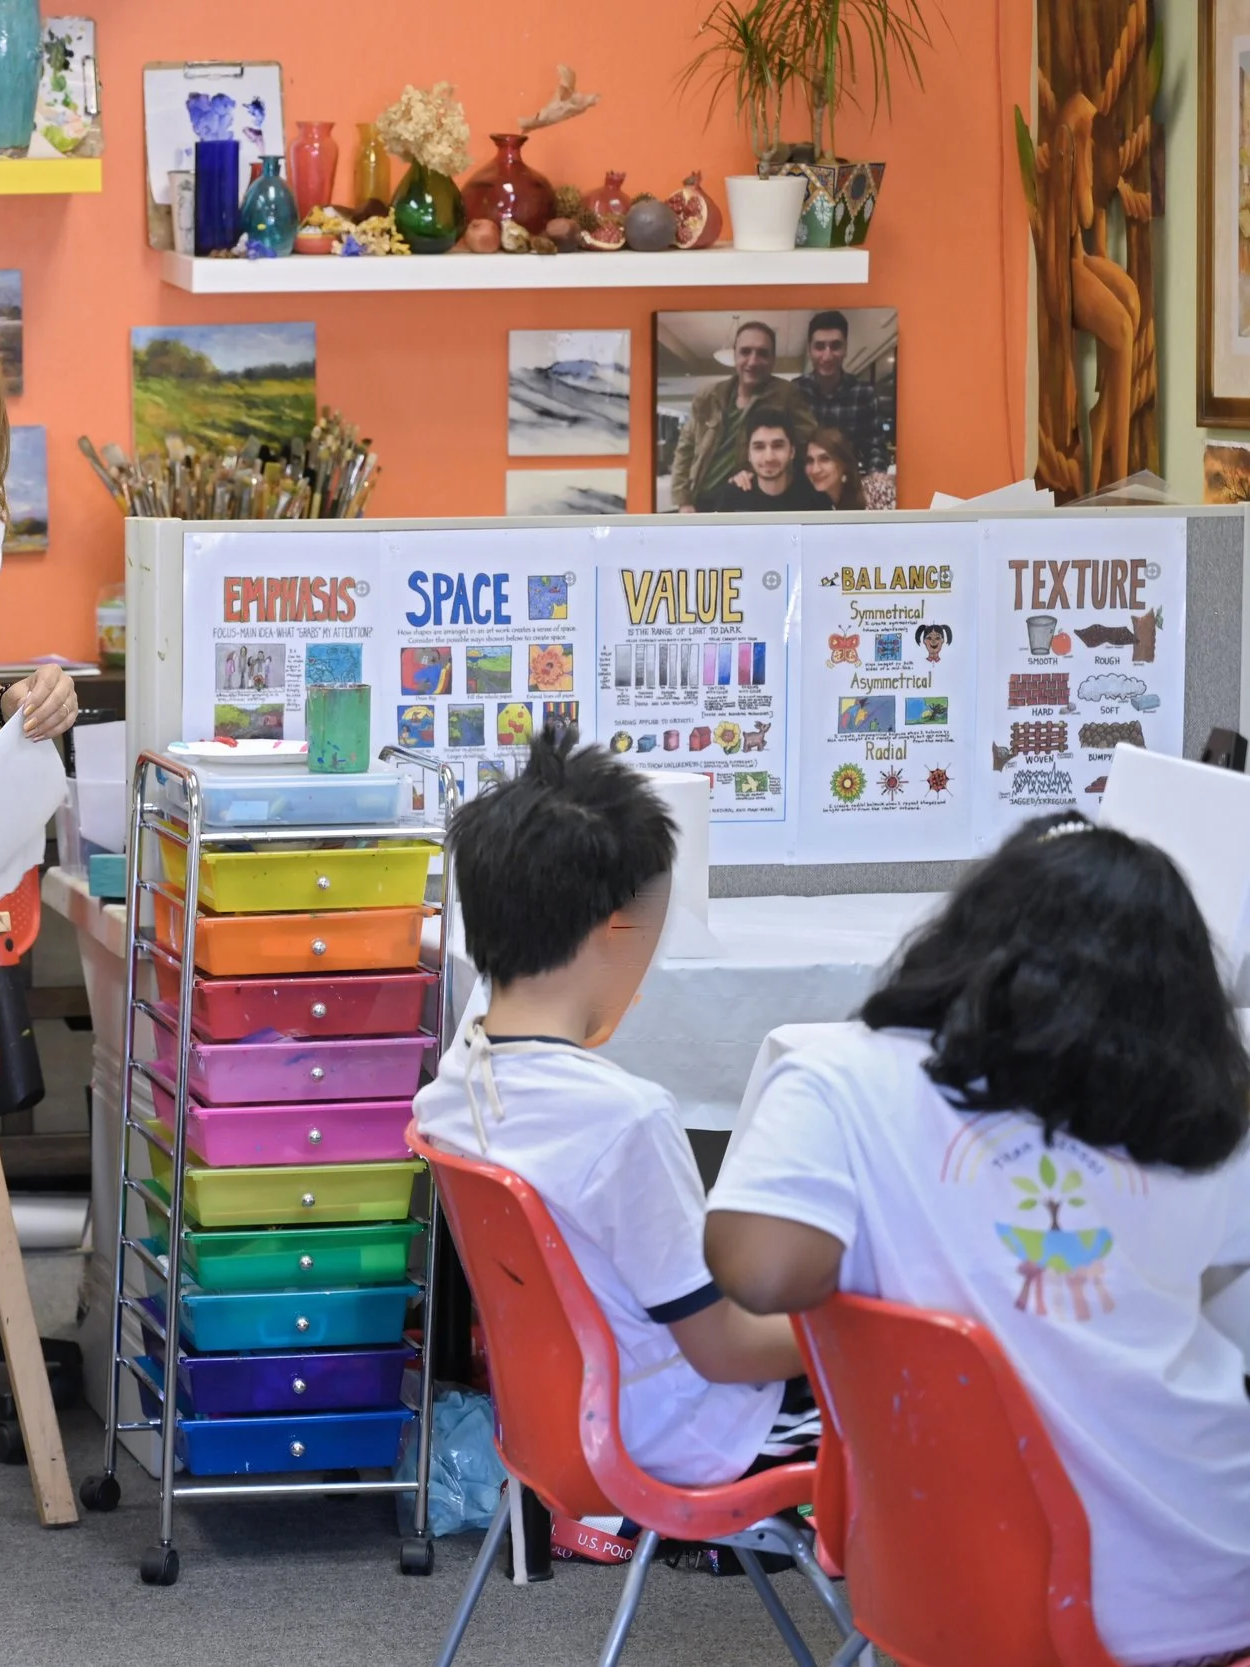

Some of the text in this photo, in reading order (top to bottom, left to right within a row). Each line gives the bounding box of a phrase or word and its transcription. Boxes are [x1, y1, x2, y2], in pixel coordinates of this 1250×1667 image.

[841, 564, 952, 591] BALANCE
[1008, 558, 1147, 611] TEXTURE
[223, 576, 356, 623] EMPHASIS
[405, 570, 511, 627] SPACE
[620, 568, 744, 625] VALUE
[850, 599, 925, 628] Symmetrical
[322, 627, 331, 638] MY
[333, 626, 373, 638] ATTENTION?
[413, 628, 432, 638] shapes
[444, 628, 468, 637] arranged
[553, 624, 561, 632] of
[652, 628, 673, 636] RANGE
[688, 627, 707, 635] LIGHT
[709, 627, 719, 635] TO
[719, 626, 742, 635] DARK
[407, 636, 434, 644] Consider
[446, 635, 469, 644] possible
[1027, 657, 1058, 665] SMOOTH
[1094, 655, 1120, 665] ROUGH
[850, 670, 932, 694] Asymmetrical
[1031, 707, 1053, 716] HARD
[1100, 706, 1120, 715] SOFT
[865, 740, 908, 761] Radial
[1025, 754, 1054, 764] WOVEN
[1088, 753, 1113, 762] BUMPY
[1009, 796, 1077, 806] JAGGED/IRREGULAR
[577, 1533, 633, 1560] U.S. POLO
